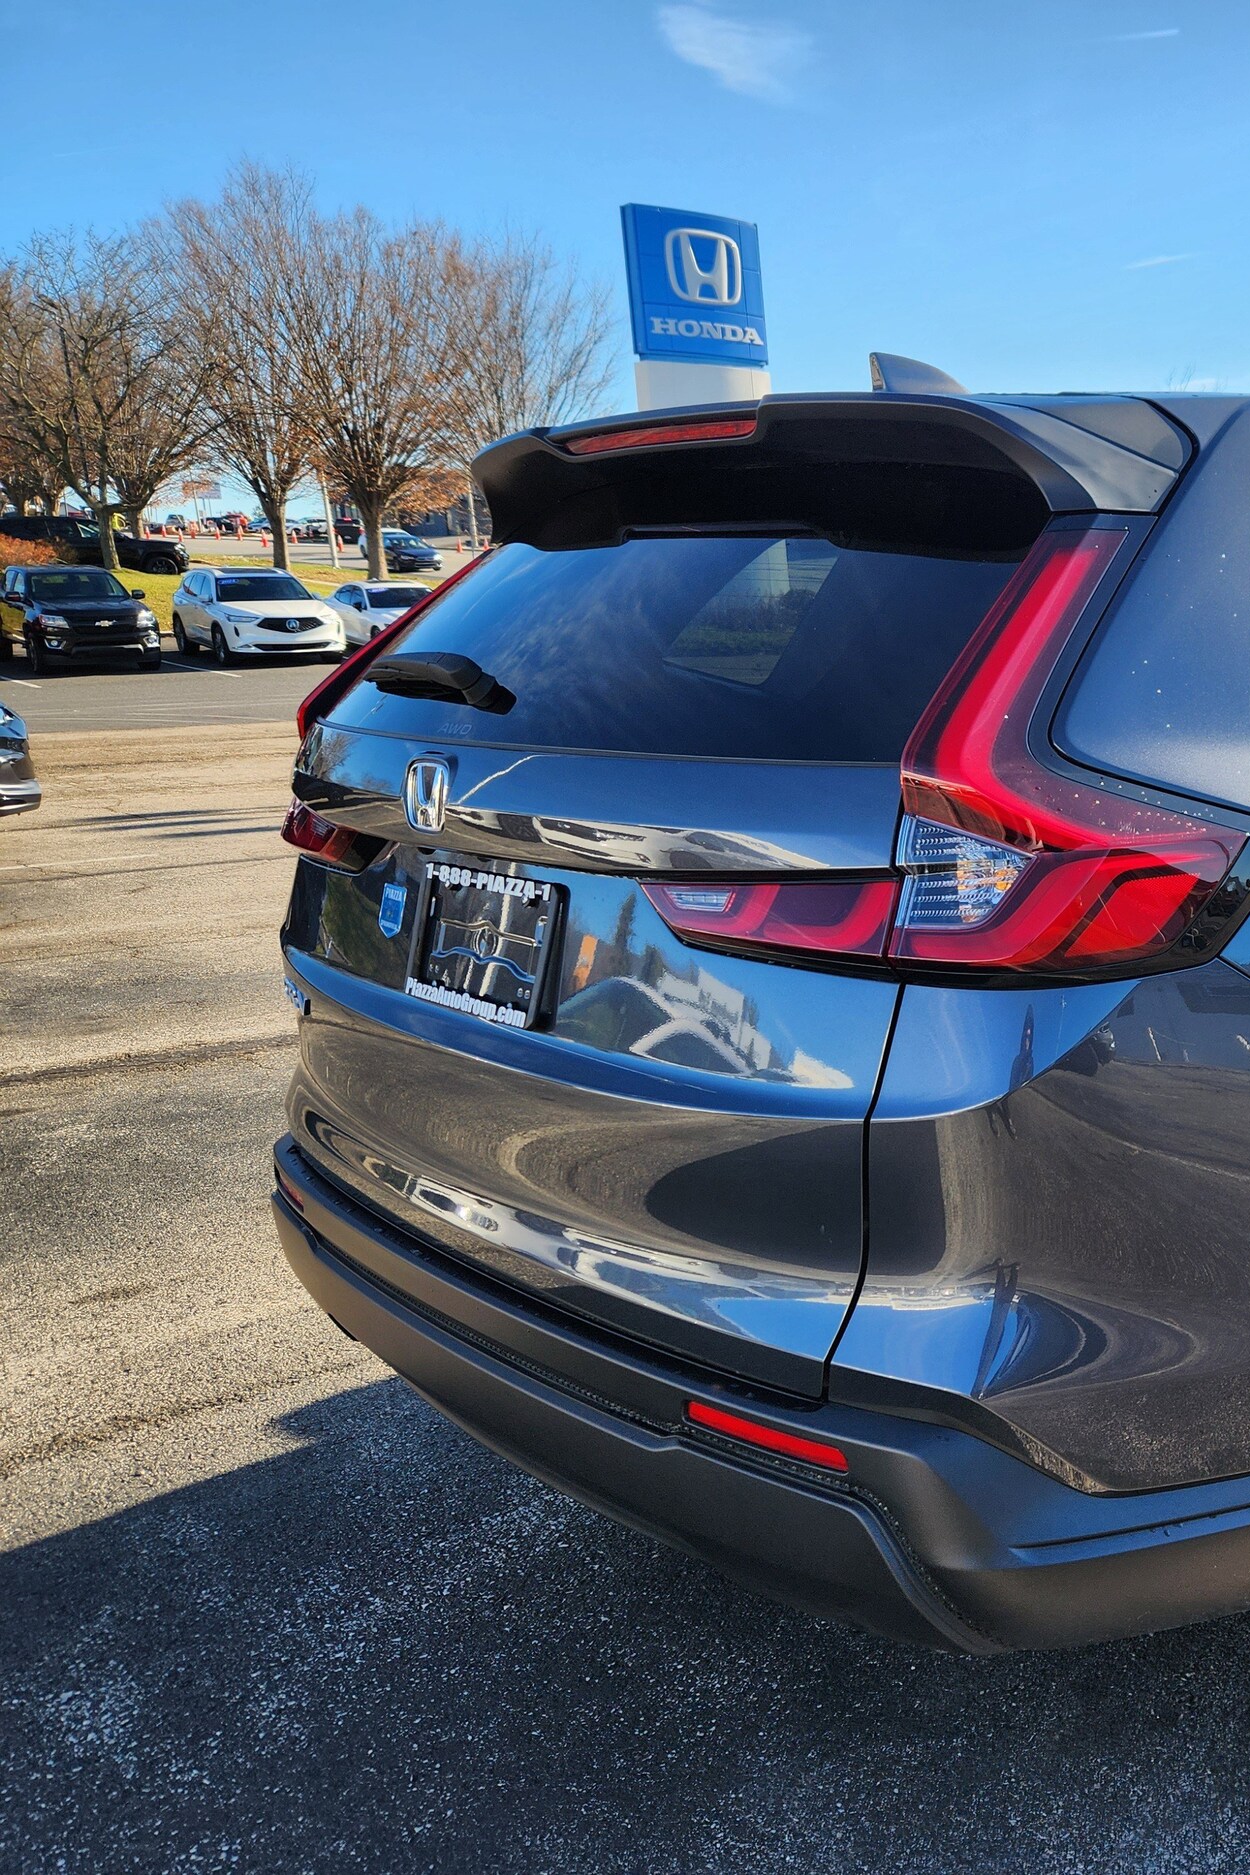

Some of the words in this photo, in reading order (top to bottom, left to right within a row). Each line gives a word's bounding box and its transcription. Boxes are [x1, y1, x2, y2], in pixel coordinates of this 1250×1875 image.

[650, 316, 764, 346] HONDA
[426, 862, 551, 901] 1-888-PIAZZA-1
[405, 977, 527, 1028] PiazzaAutoGroup.com
